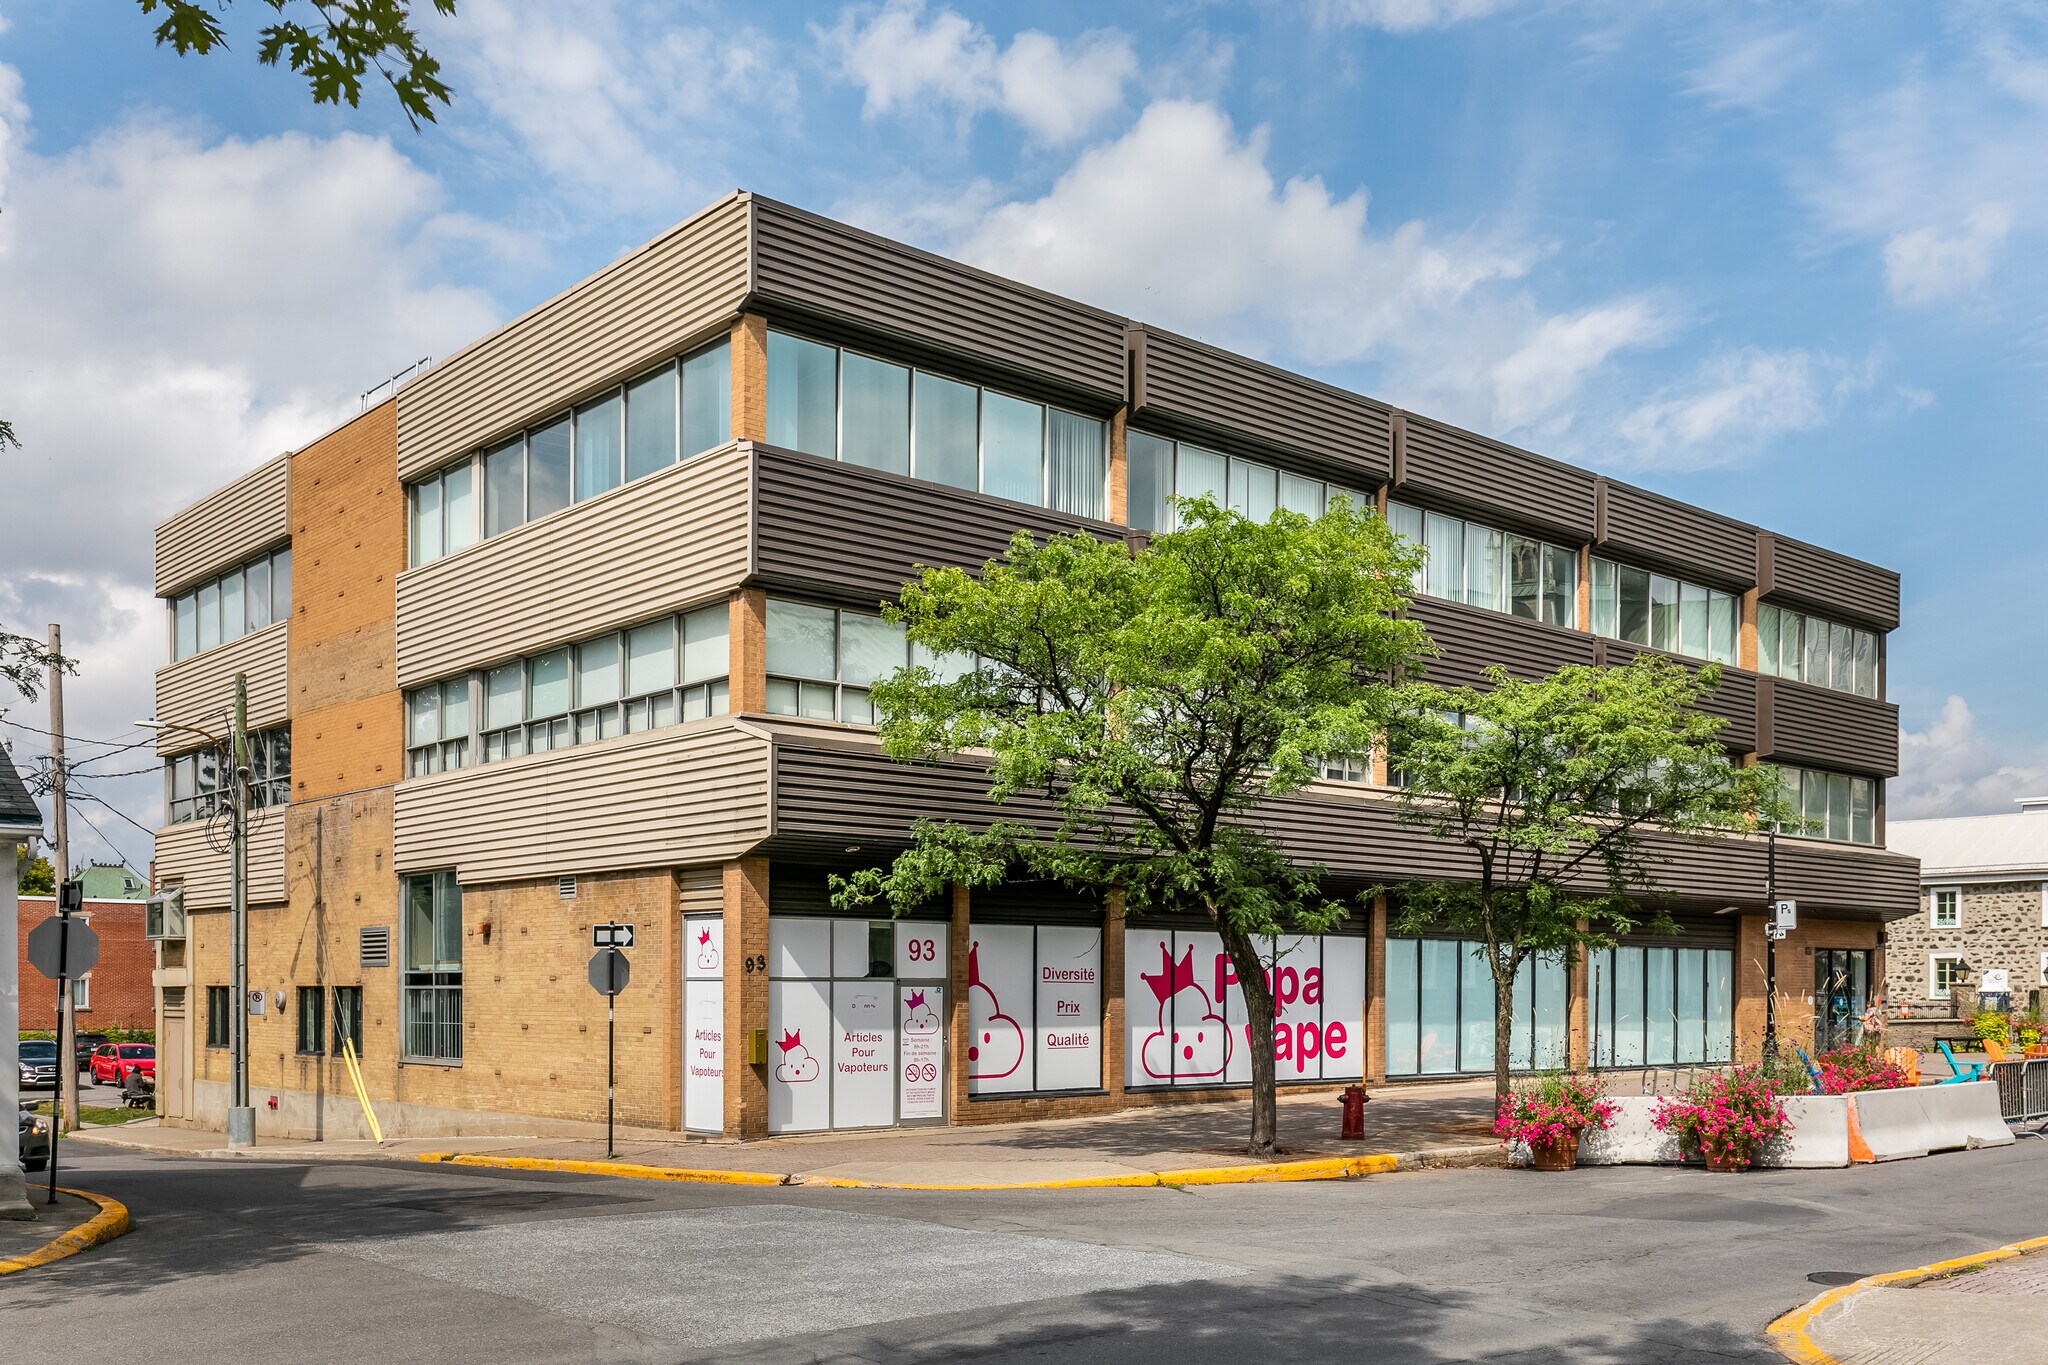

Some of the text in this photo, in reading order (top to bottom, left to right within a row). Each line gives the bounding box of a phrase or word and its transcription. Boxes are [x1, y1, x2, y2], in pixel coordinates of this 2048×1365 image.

[908, 938, 936, 962] 93
[745, 954, 767, 974] 93
[1042, 966, 1095, 981] Diversité
[1214, 952, 1325, 1018] Ppa
[1057, 1000, 1081, 1013] Prix
[694, 1028, 722, 1042] Articles
[843, 1032, 883, 1043] Articles
[1046, 1032, 1090, 1047] Qualité
[699, 1047, 716, 1059] Pour
[851, 1047, 876, 1058] Pour
[837, 1062, 889, 1075] Vapoteurs
